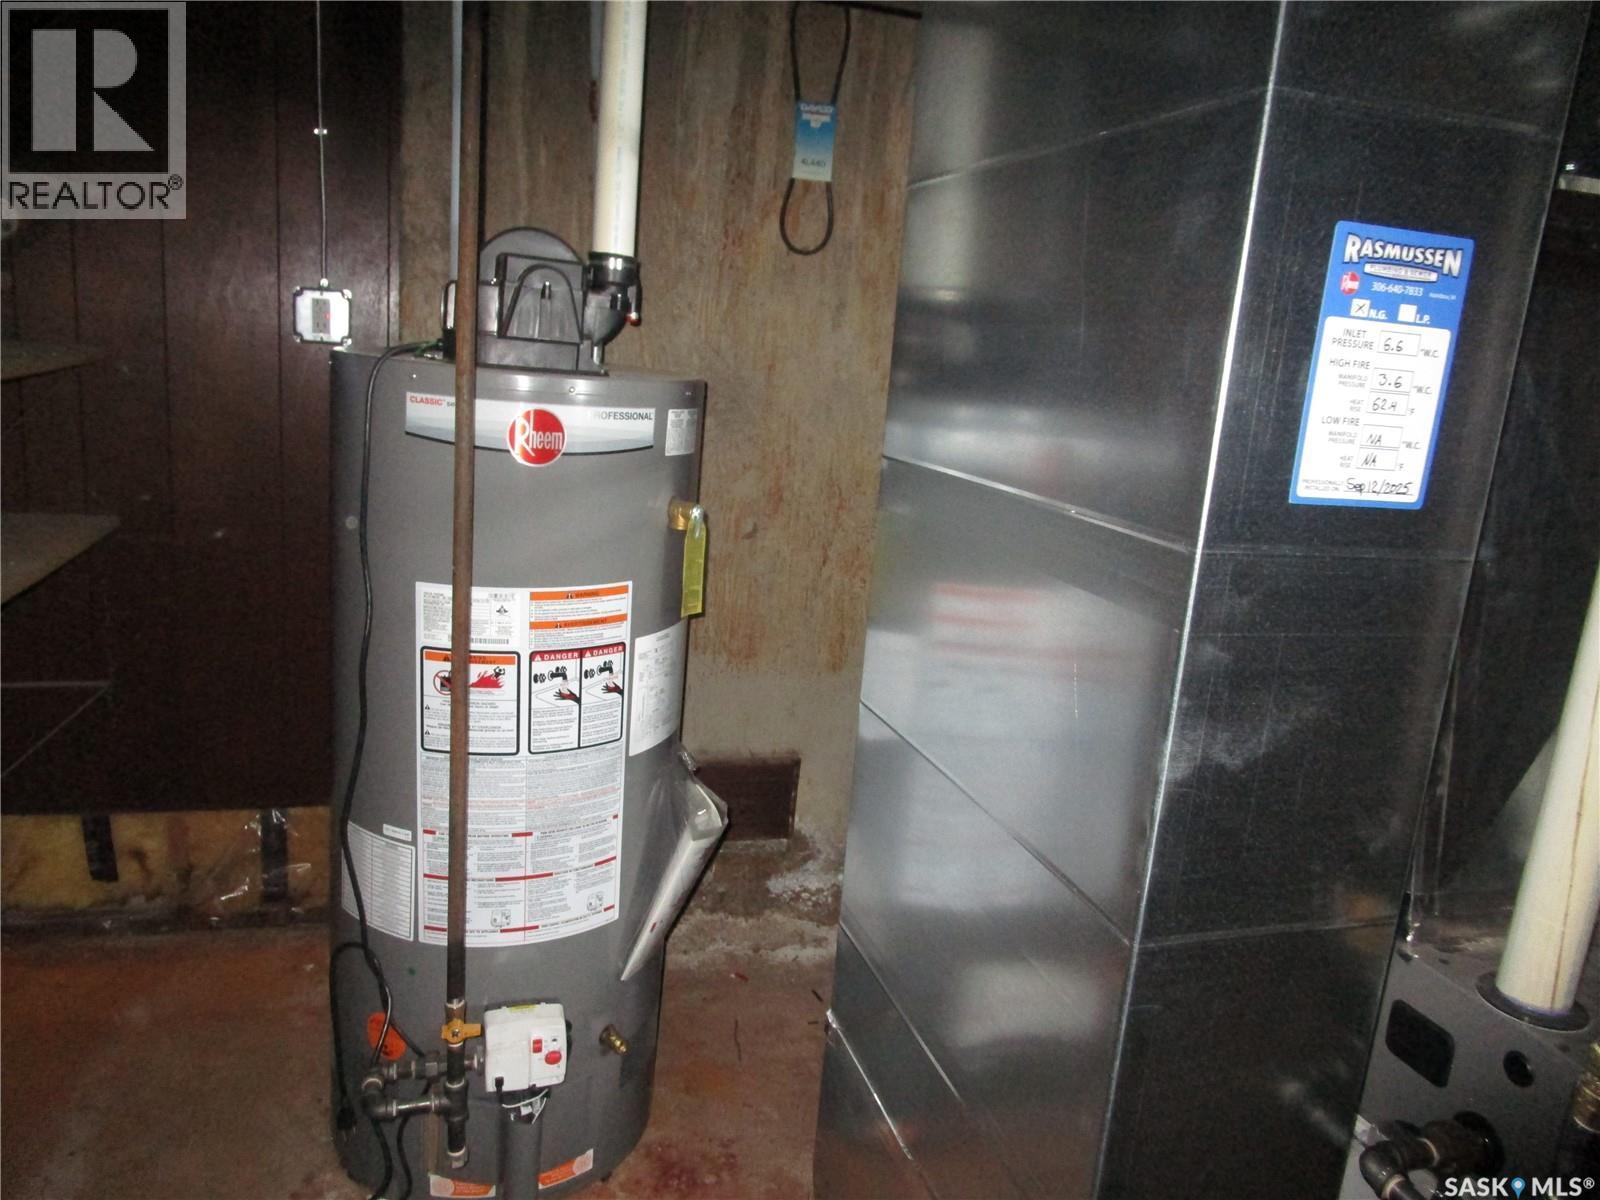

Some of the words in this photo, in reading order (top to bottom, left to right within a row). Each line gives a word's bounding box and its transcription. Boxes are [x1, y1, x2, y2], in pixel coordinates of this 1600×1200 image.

[1343, 233, 1464, 278] RASMUSSEN
[1369, 309, 1388, 320] N.G.
[1415, 313, 1431, 324] L.P.
[1343, 328, 1368, 339] INLET
[1332, 337, 1375, 350] PRESSURE
[1329, 358, 1351, 367] HIGH
[1352, 360, 1371, 369] FIRE
[1378, 373, 1403, 389] 3.6
[1321, 416, 1341, 425] LOW
[1342, 417, 1360, 427] FIRE
[513, 409, 563, 457] Rheem
[543, 652, 579, 661] DANGER
[592, 646, 623, 656] DANGER
